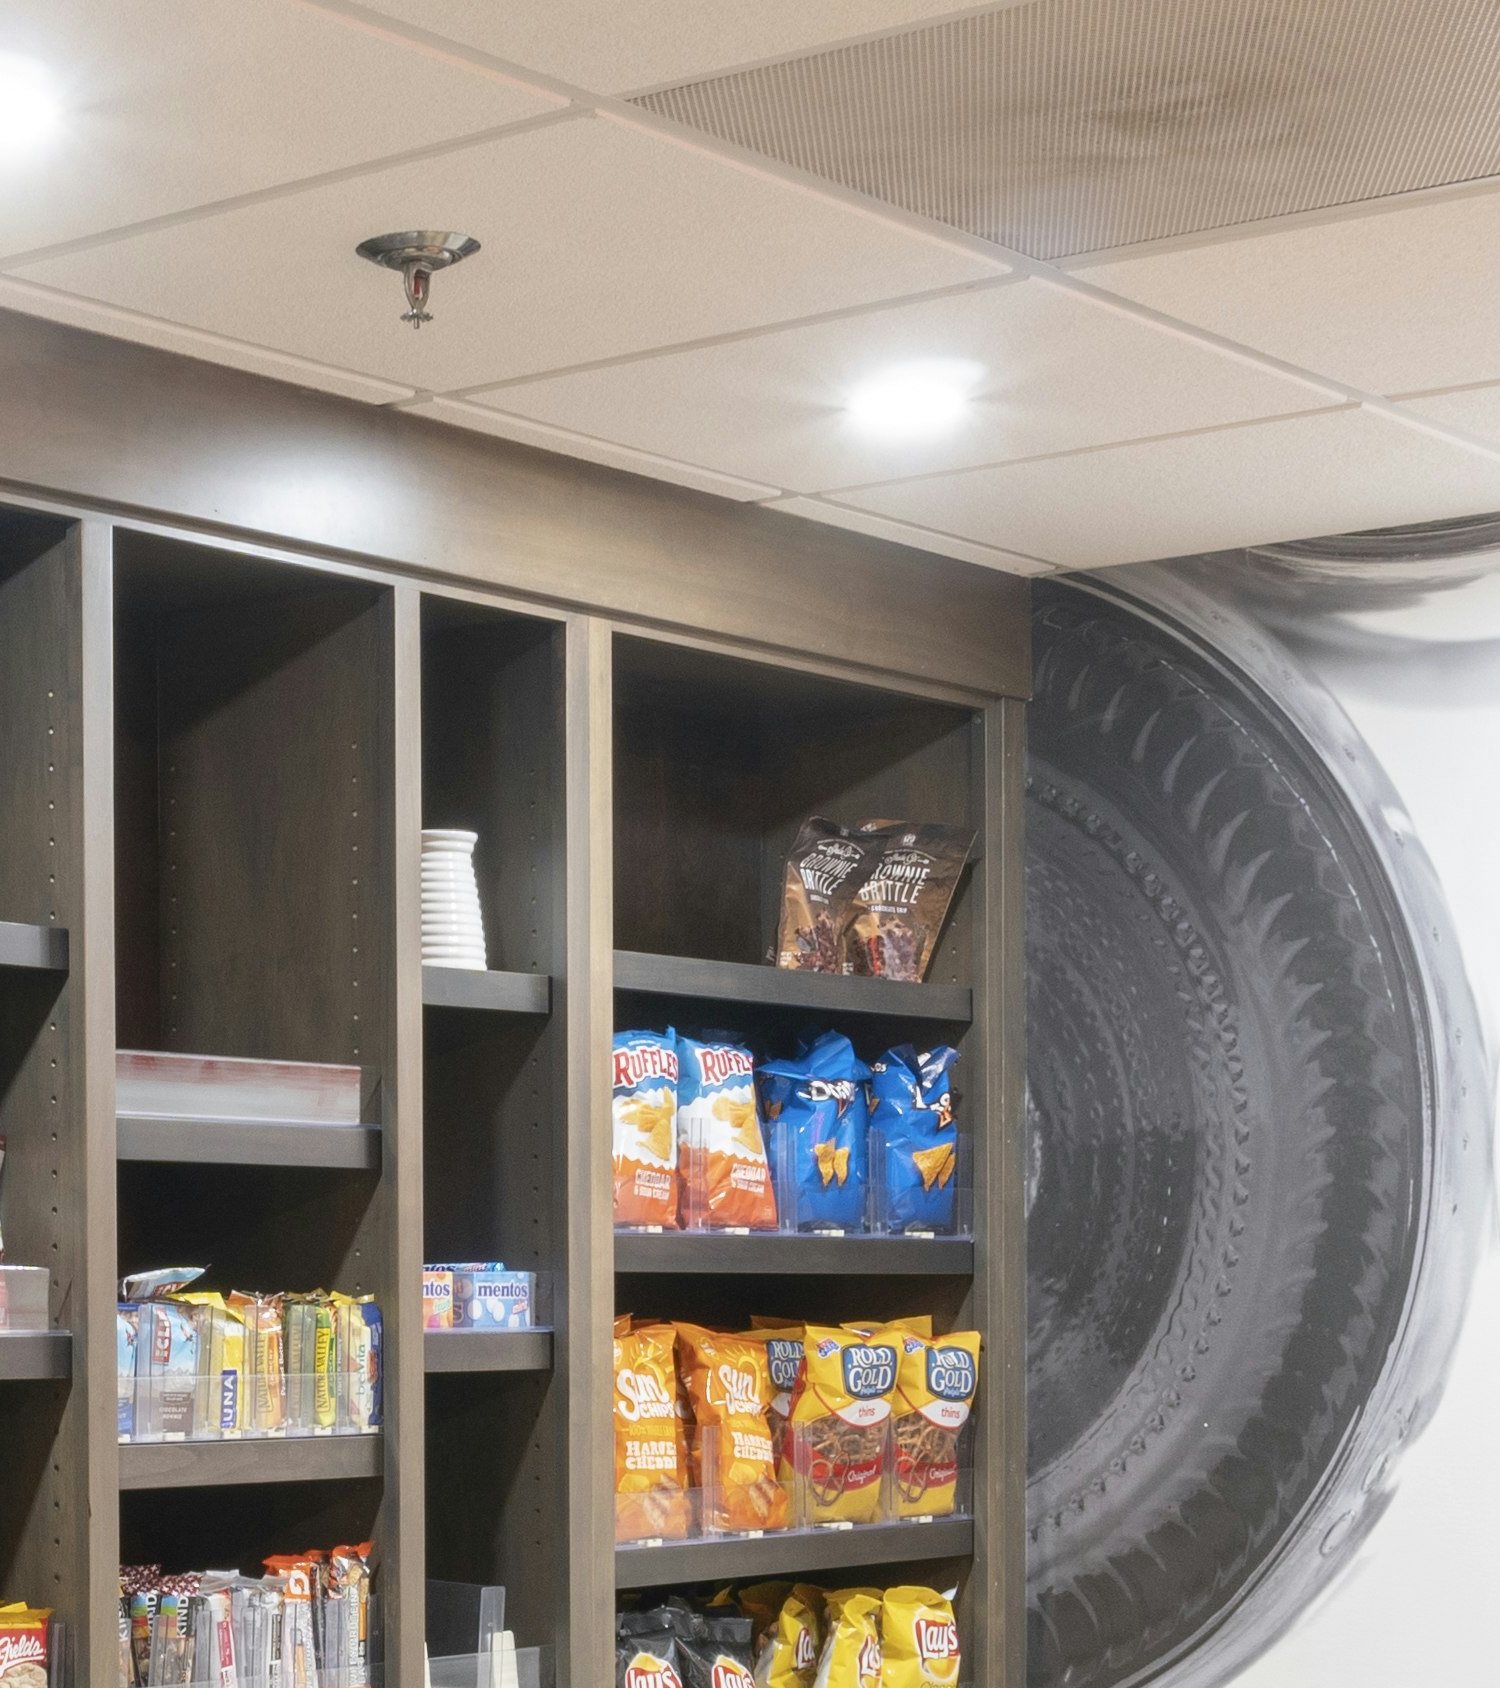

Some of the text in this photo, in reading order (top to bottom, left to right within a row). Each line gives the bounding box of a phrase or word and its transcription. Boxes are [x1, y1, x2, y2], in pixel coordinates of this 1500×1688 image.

[799, 852, 858, 879] BROWNIE
[613, 1047, 679, 1088] RUFFLES
[635, 1170, 671, 1187] CHEDDAR
[731, 1163, 767, 1180] CHEDDAR
[477, 1281, 528, 1298] mentos
[851, 1347, 892, 1367] ROLD
[934, 1348, 970, 1368] ROLD
[848, 1364, 895, 1394] GOLD
[930, 1365, 973, 1394] GOLD
[858, 1405, 875, 1418] thins
[176, 1596, 190, 1639] KIND
[917, 1618, 959, 1660] Lay's
